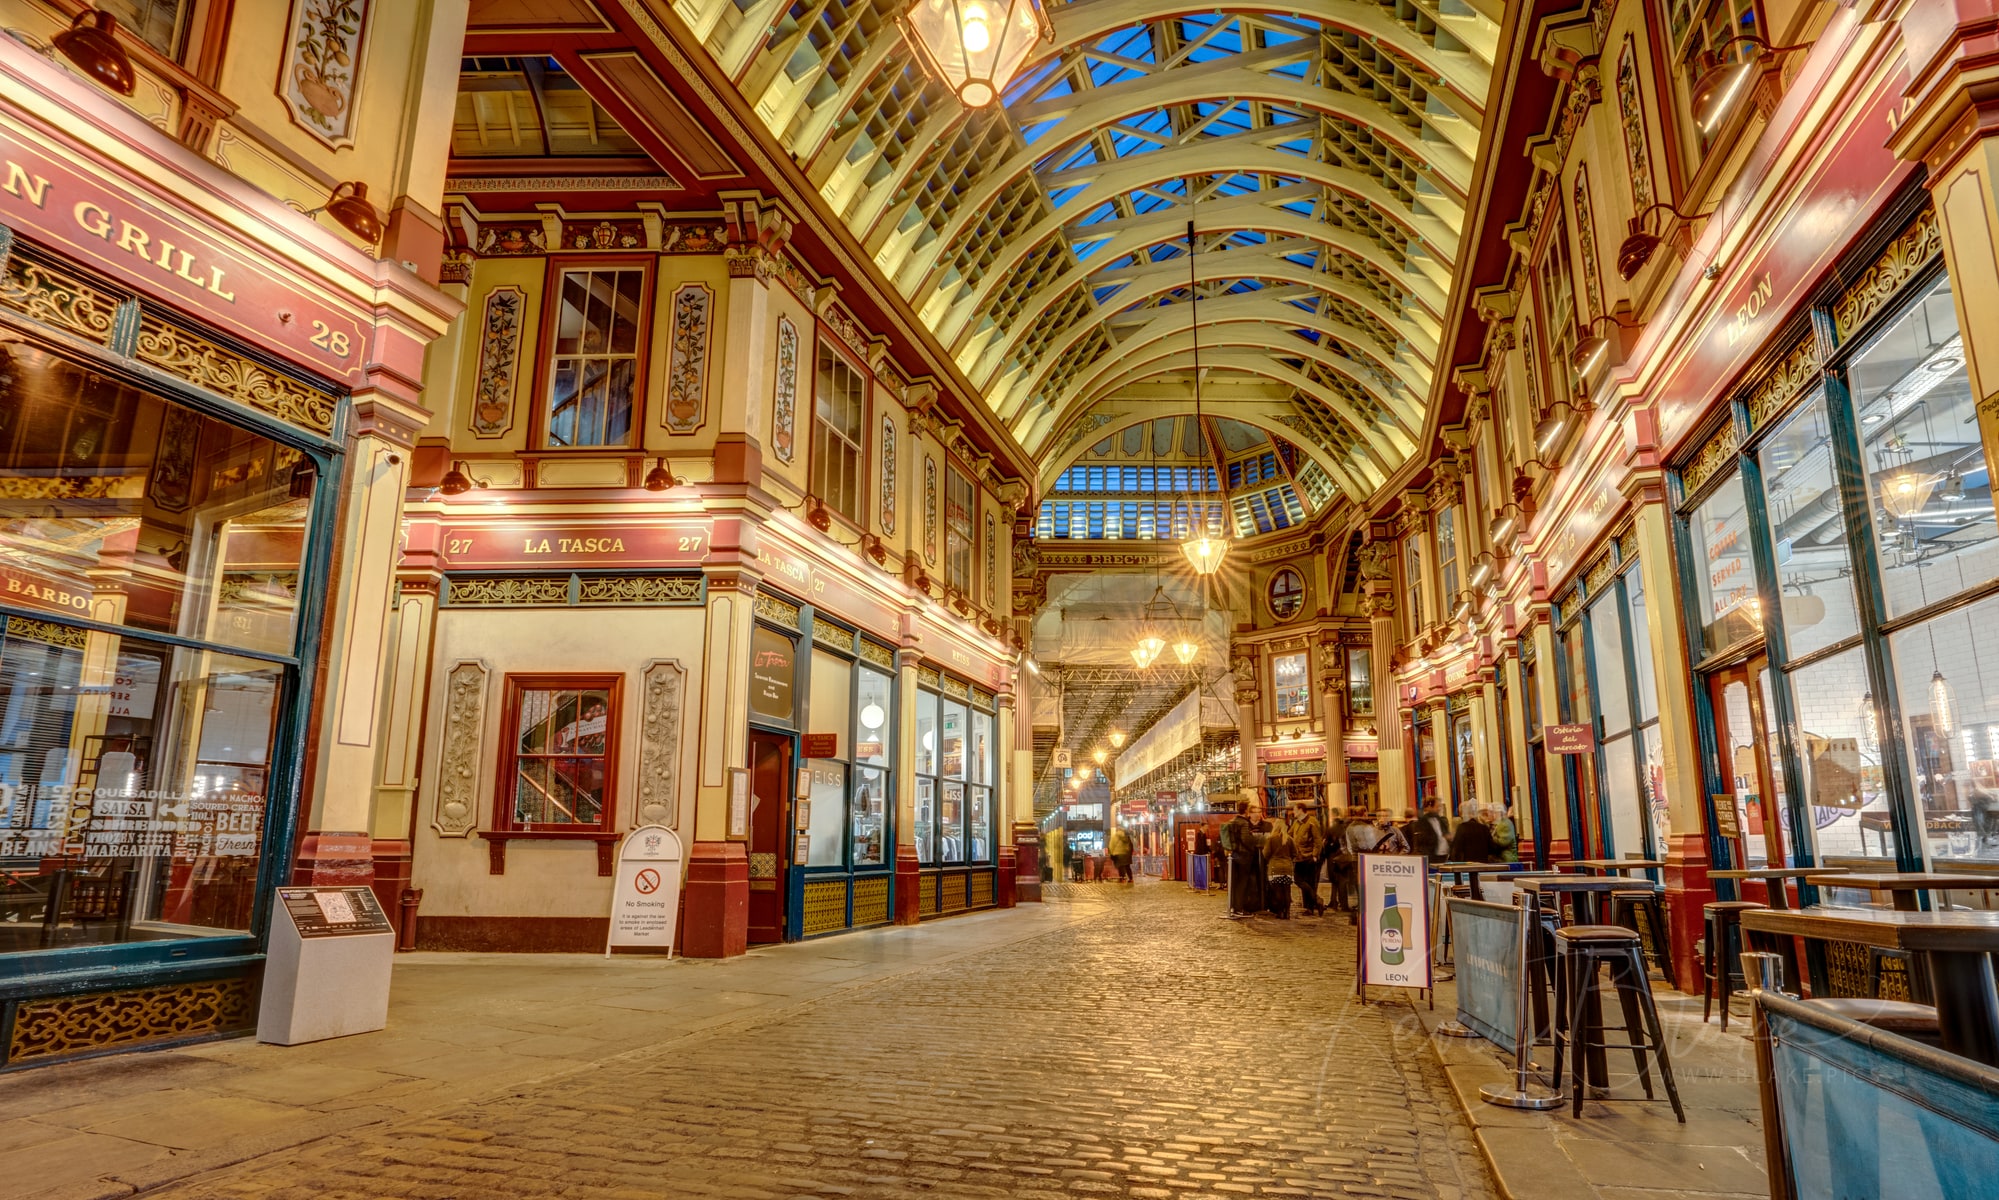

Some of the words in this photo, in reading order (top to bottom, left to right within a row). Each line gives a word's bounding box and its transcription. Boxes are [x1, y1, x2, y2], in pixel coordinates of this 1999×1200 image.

[73, 200, 236, 304] GRILL
[308, 319, 352, 358] 28
[1726, 271, 1775, 348] LEON
[449, 539, 473, 555] 27
[524, 538, 552, 554] LA
[558, 537, 626, 553] TASCA
[678, 536, 704, 552] 27
[757, 548, 772, 567] LA
[774, 557, 805, 584] TASCA
[1712, 557, 1742, 587] SERVED
[813, 578, 825, 595] 27
[1715, 596, 1729, 614] ALL
[951, 649, 971, 667] REISS
[1552, 726, 1584, 735] Osteria
[1561, 735, 1578, 743] del
[1269, 750, 1282, 758] THE
[1284, 748, 1298, 757] PEN
[1300, 747, 1320, 756] SHOP
[94, 787, 187, 800] QUESADILLA
[229, 794, 265, 804] NACHOS
[99, 801, 147, 816] SALSA
[191, 802, 230, 811] SOURED
[62, 787, 93, 856] TACO
[89, 818, 202, 832] SHREDDED
[215, 811, 261, 832] BEEF
[86, 830, 136, 844] FROZEN
[1076, 831, 1094, 841] pod
[1, 840, 60, 857] BEANS
[84, 844, 172, 858] MARGARITA
[174, 833, 188, 857] RICE
[217, 837, 256, 851] Fresh
[1372, 864, 1415, 874] PERONI
[625, 900, 635, 908] No
[636, 900, 665, 909] Smoking
[1385, 973, 1409, 983] LEON
